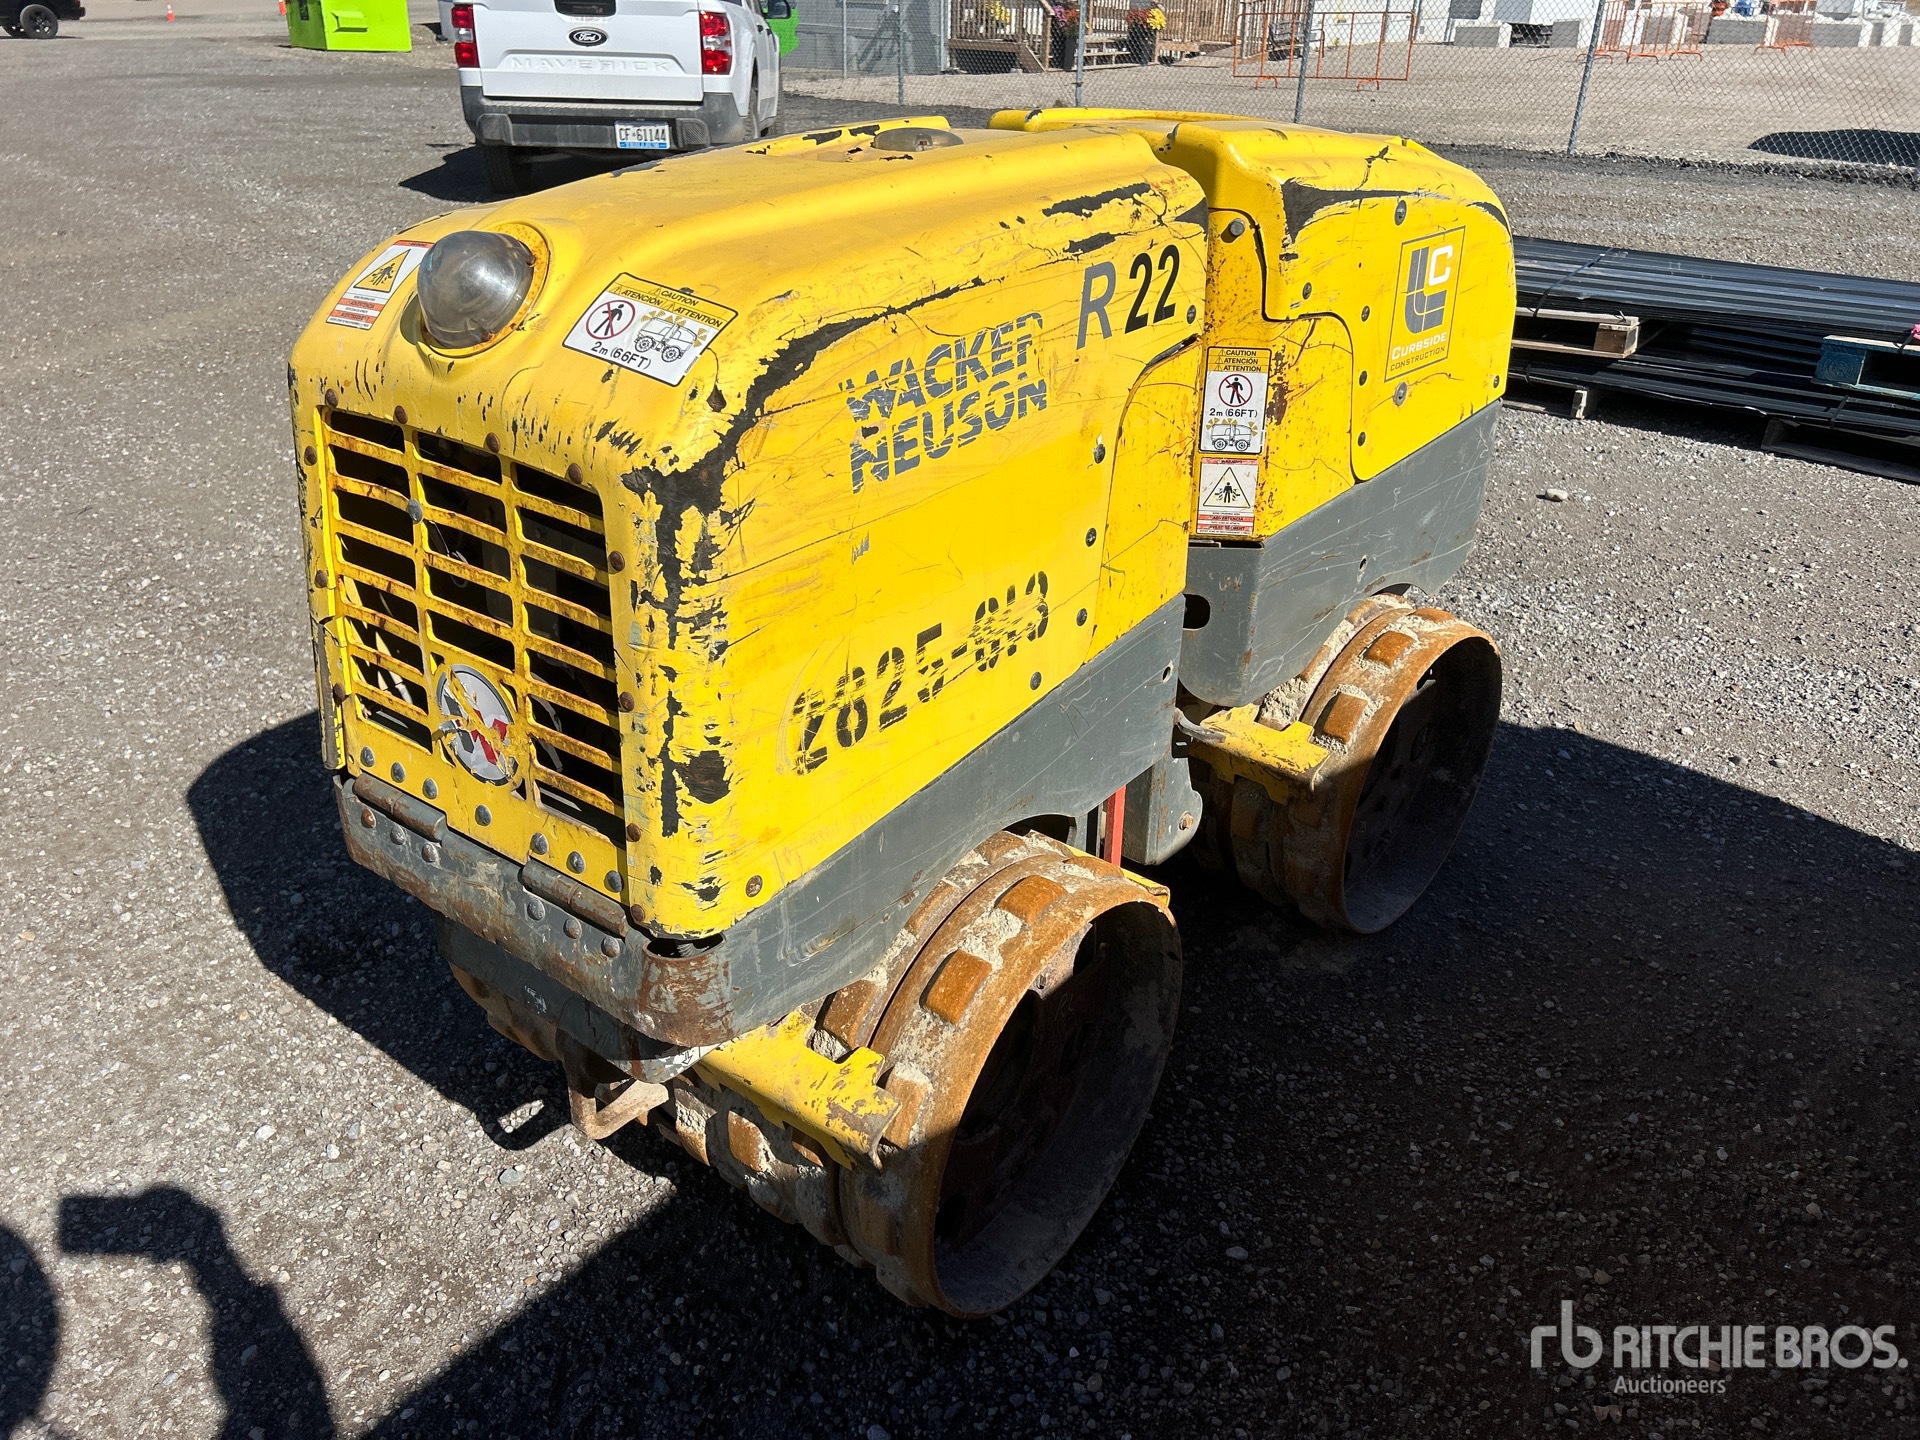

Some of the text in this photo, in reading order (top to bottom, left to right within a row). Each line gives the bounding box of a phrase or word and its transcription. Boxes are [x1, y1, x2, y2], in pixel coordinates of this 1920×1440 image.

[511, 57, 670, 72] MAVERICK
[660, 289, 700, 307] CAUTION
[674, 306, 723, 328] ATTENTION
[1225, 349, 1257, 357] CAUTION
[1390, 331, 1448, 361] CURBSIDE
[838, 312, 1043, 421] WACKER
[1223, 364, 1262, 372] ATTENTION
[1389, 345, 1446, 372] CONSTRUCTION
[849, 371, 1048, 495] NEUSON
